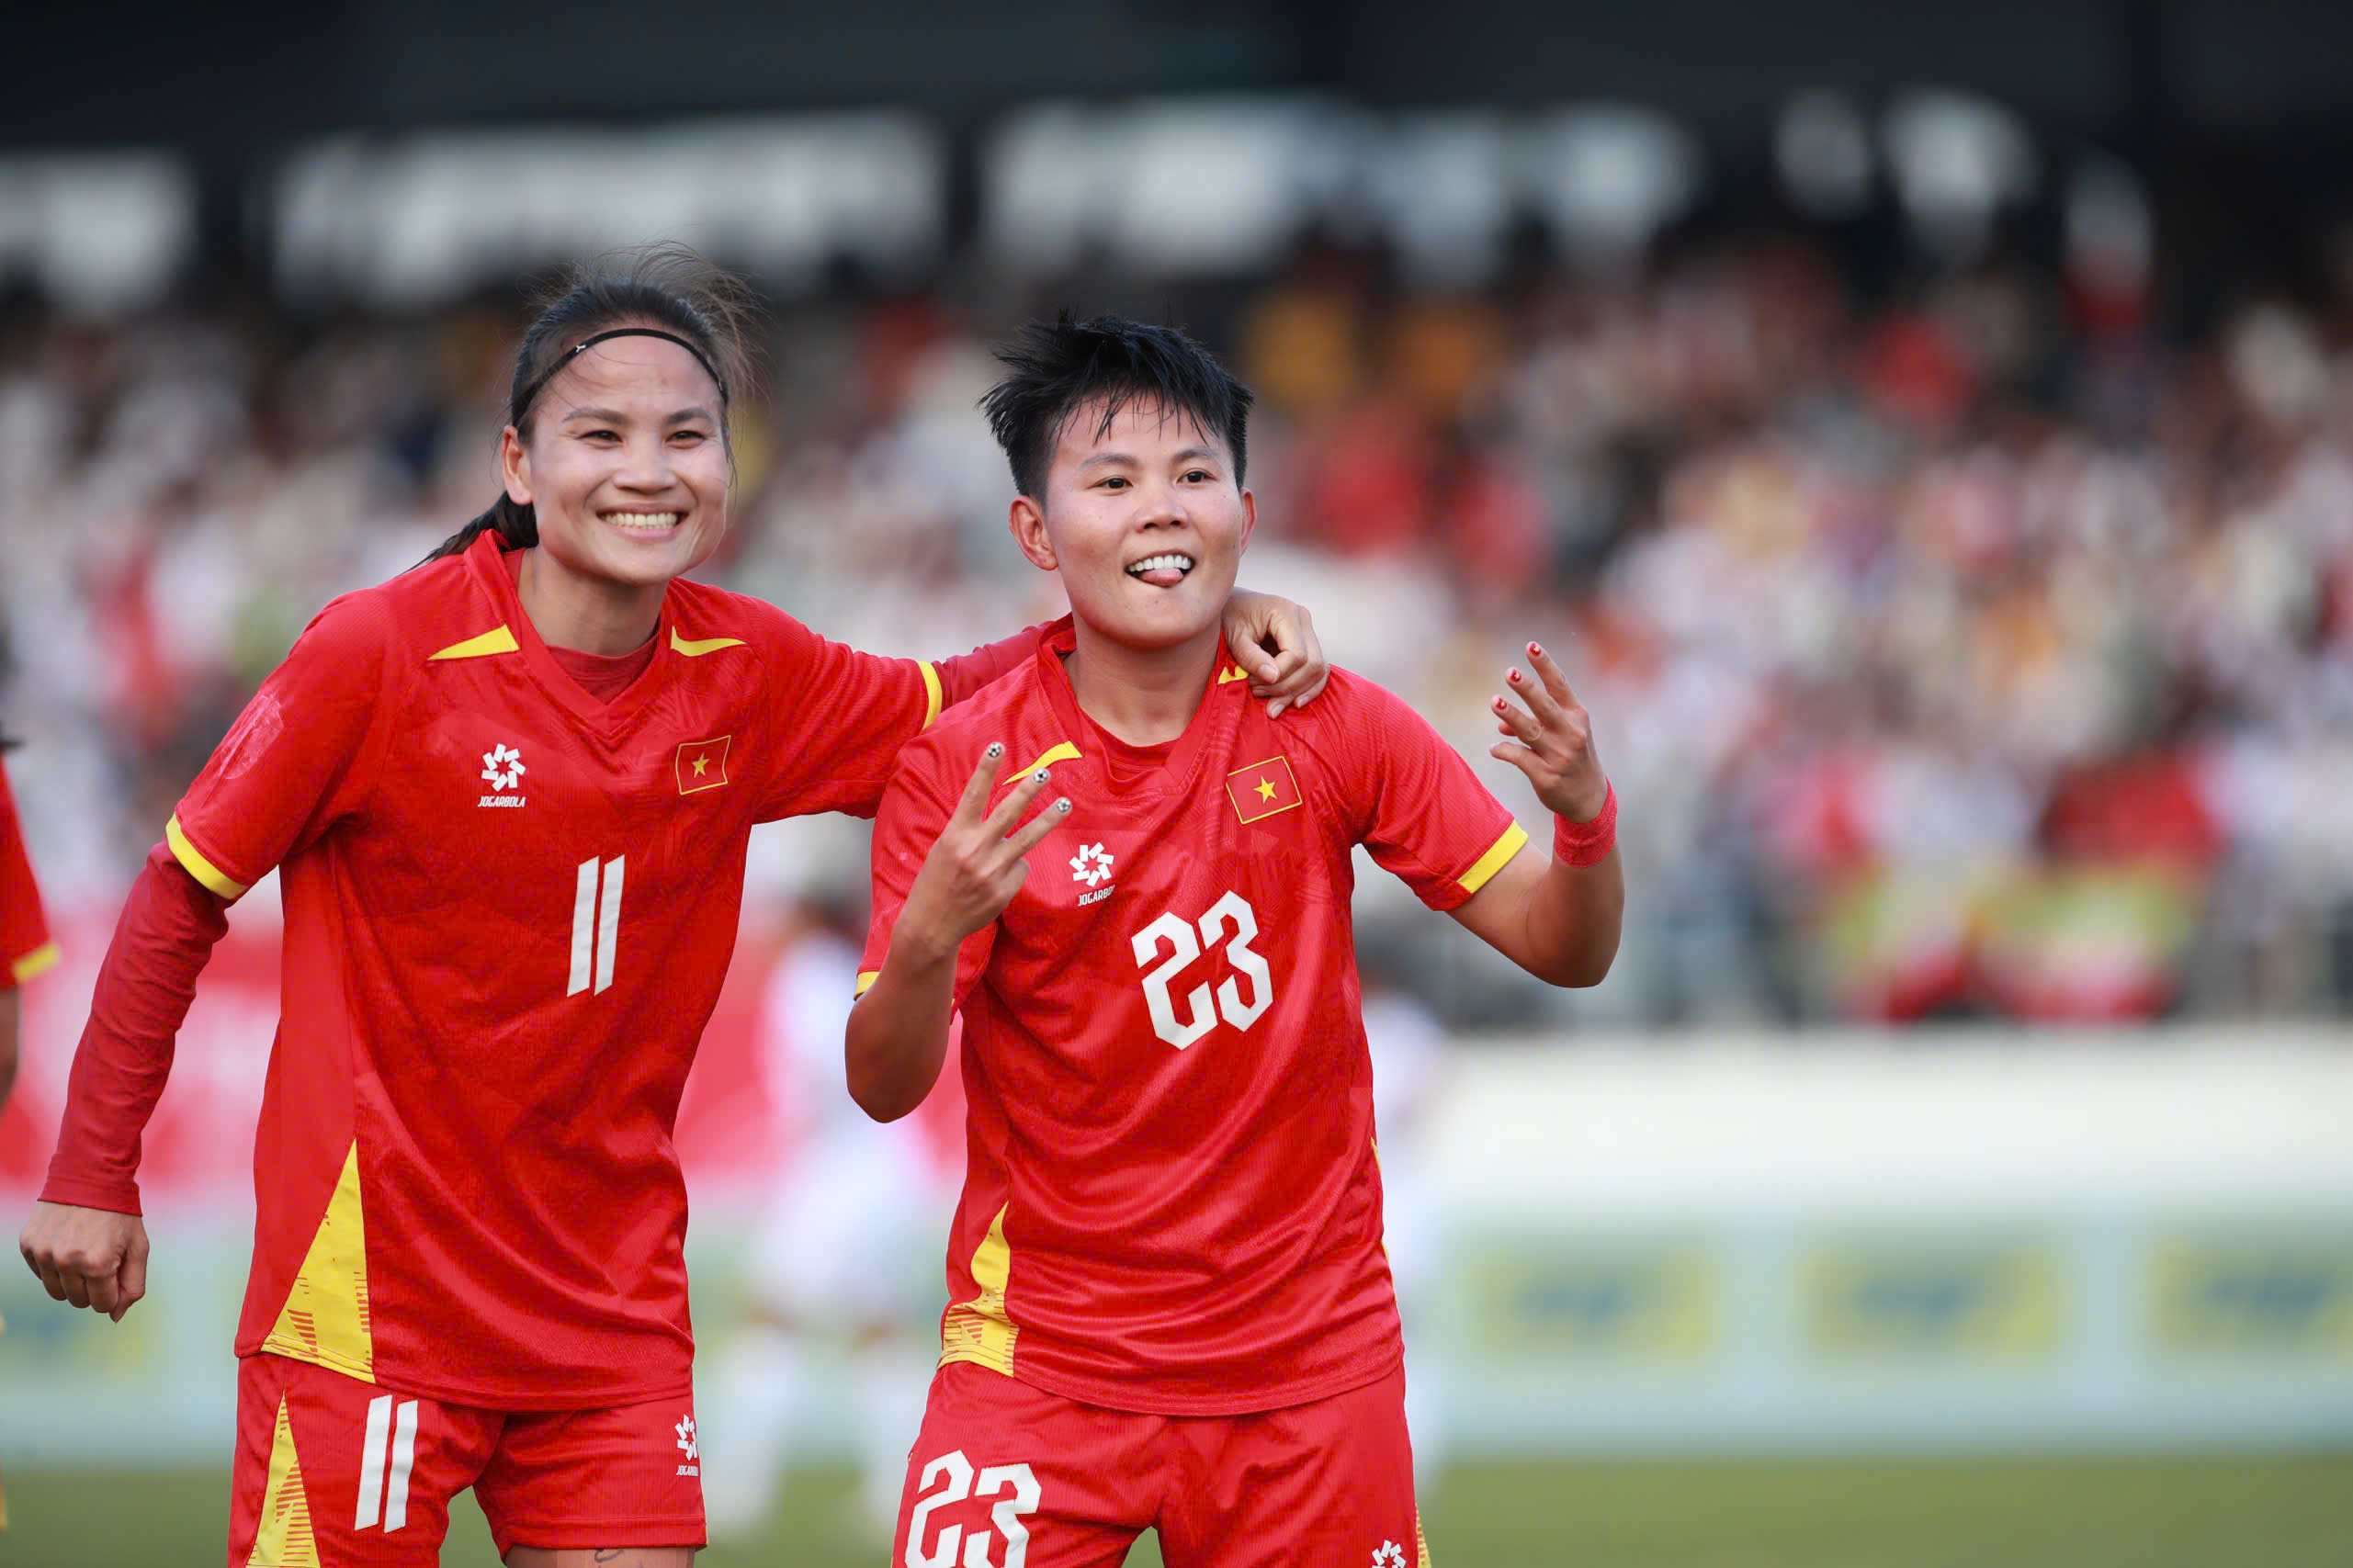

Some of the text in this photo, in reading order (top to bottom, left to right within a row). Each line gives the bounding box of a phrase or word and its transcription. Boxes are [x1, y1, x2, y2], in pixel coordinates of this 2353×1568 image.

[477, 795, 526, 807] JOGARBOLA
[567, 854, 625, 997] 11
[1131, 890, 1273, 1051] 23
[355, 1394, 418, 1533] 11
[905, 1450, 1042, 1568] 23
